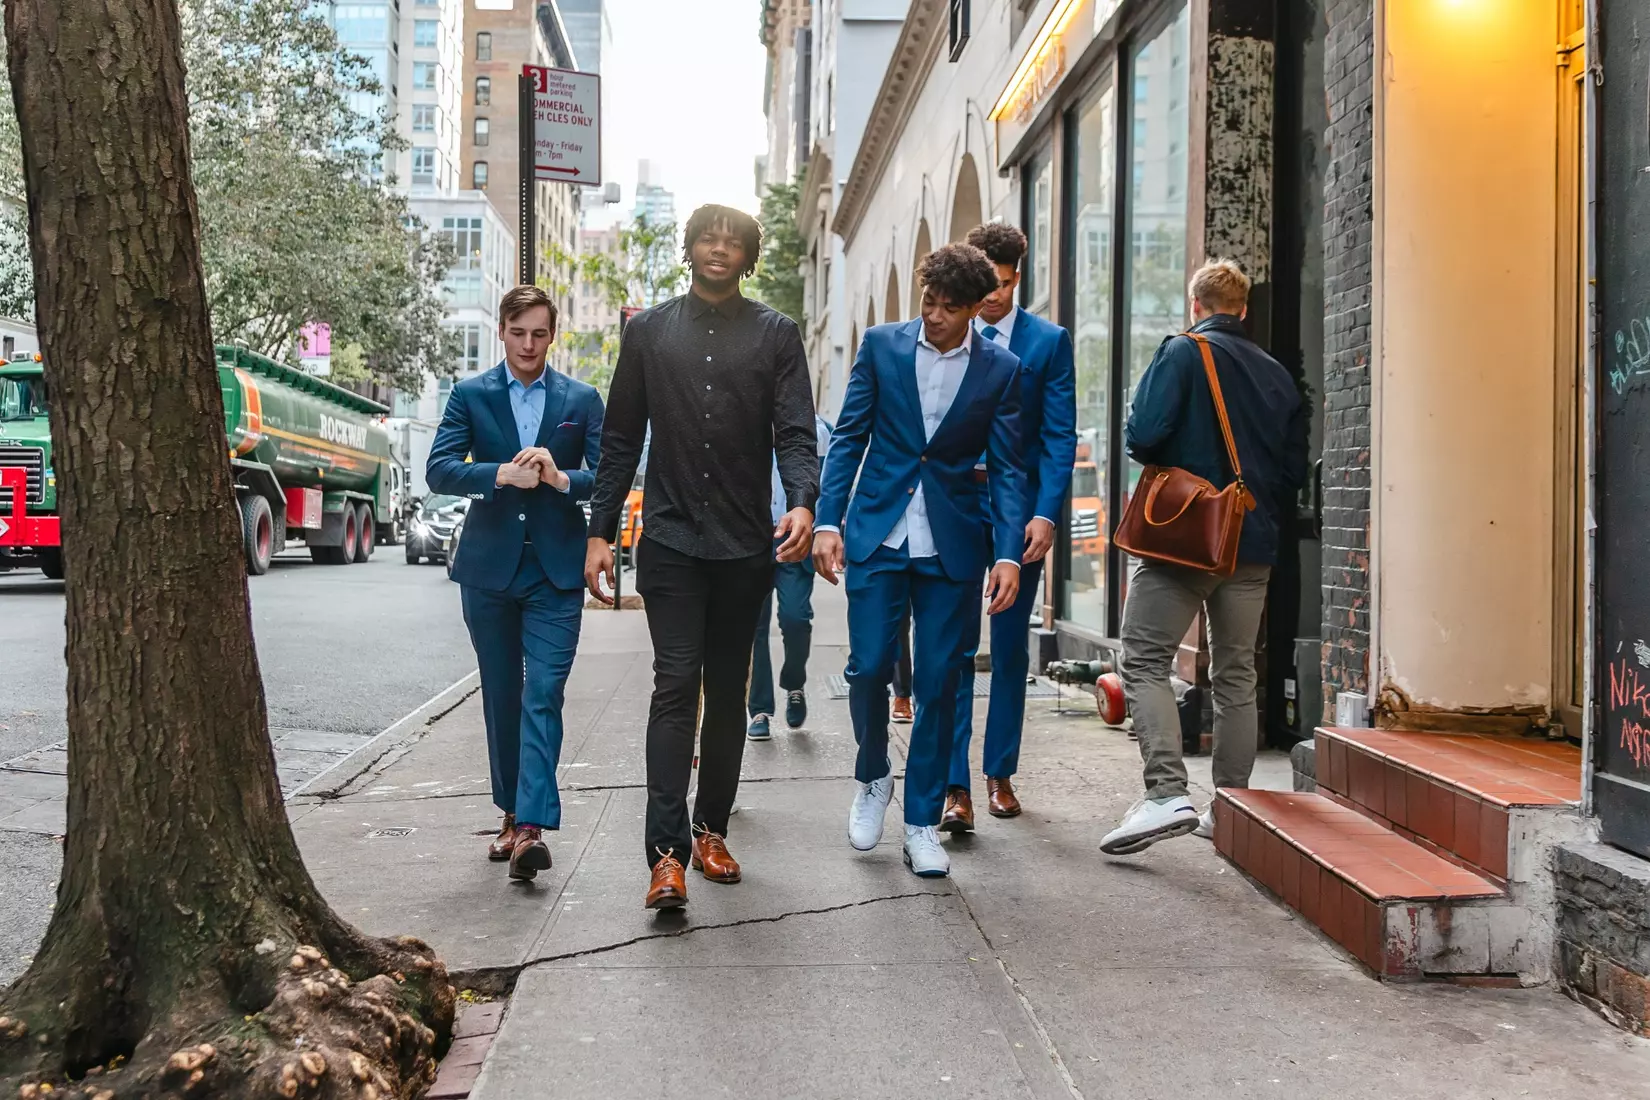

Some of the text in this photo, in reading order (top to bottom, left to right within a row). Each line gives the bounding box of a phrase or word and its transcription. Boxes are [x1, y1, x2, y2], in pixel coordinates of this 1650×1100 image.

[529, 68, 542, 91] 3
[550, 82, 576, 90] metered
[550, 89, 573, 98] parking
[534, 99, 584, 114] OMMERCIAL
[571, 115, 593, 127] ONLY
[534, 139, 555, 150] nday
[561, 141, 583, 154] Friday
[548, 150, 563, 160] 7pm
[319, 413, 368, 450] ROCKWAY
